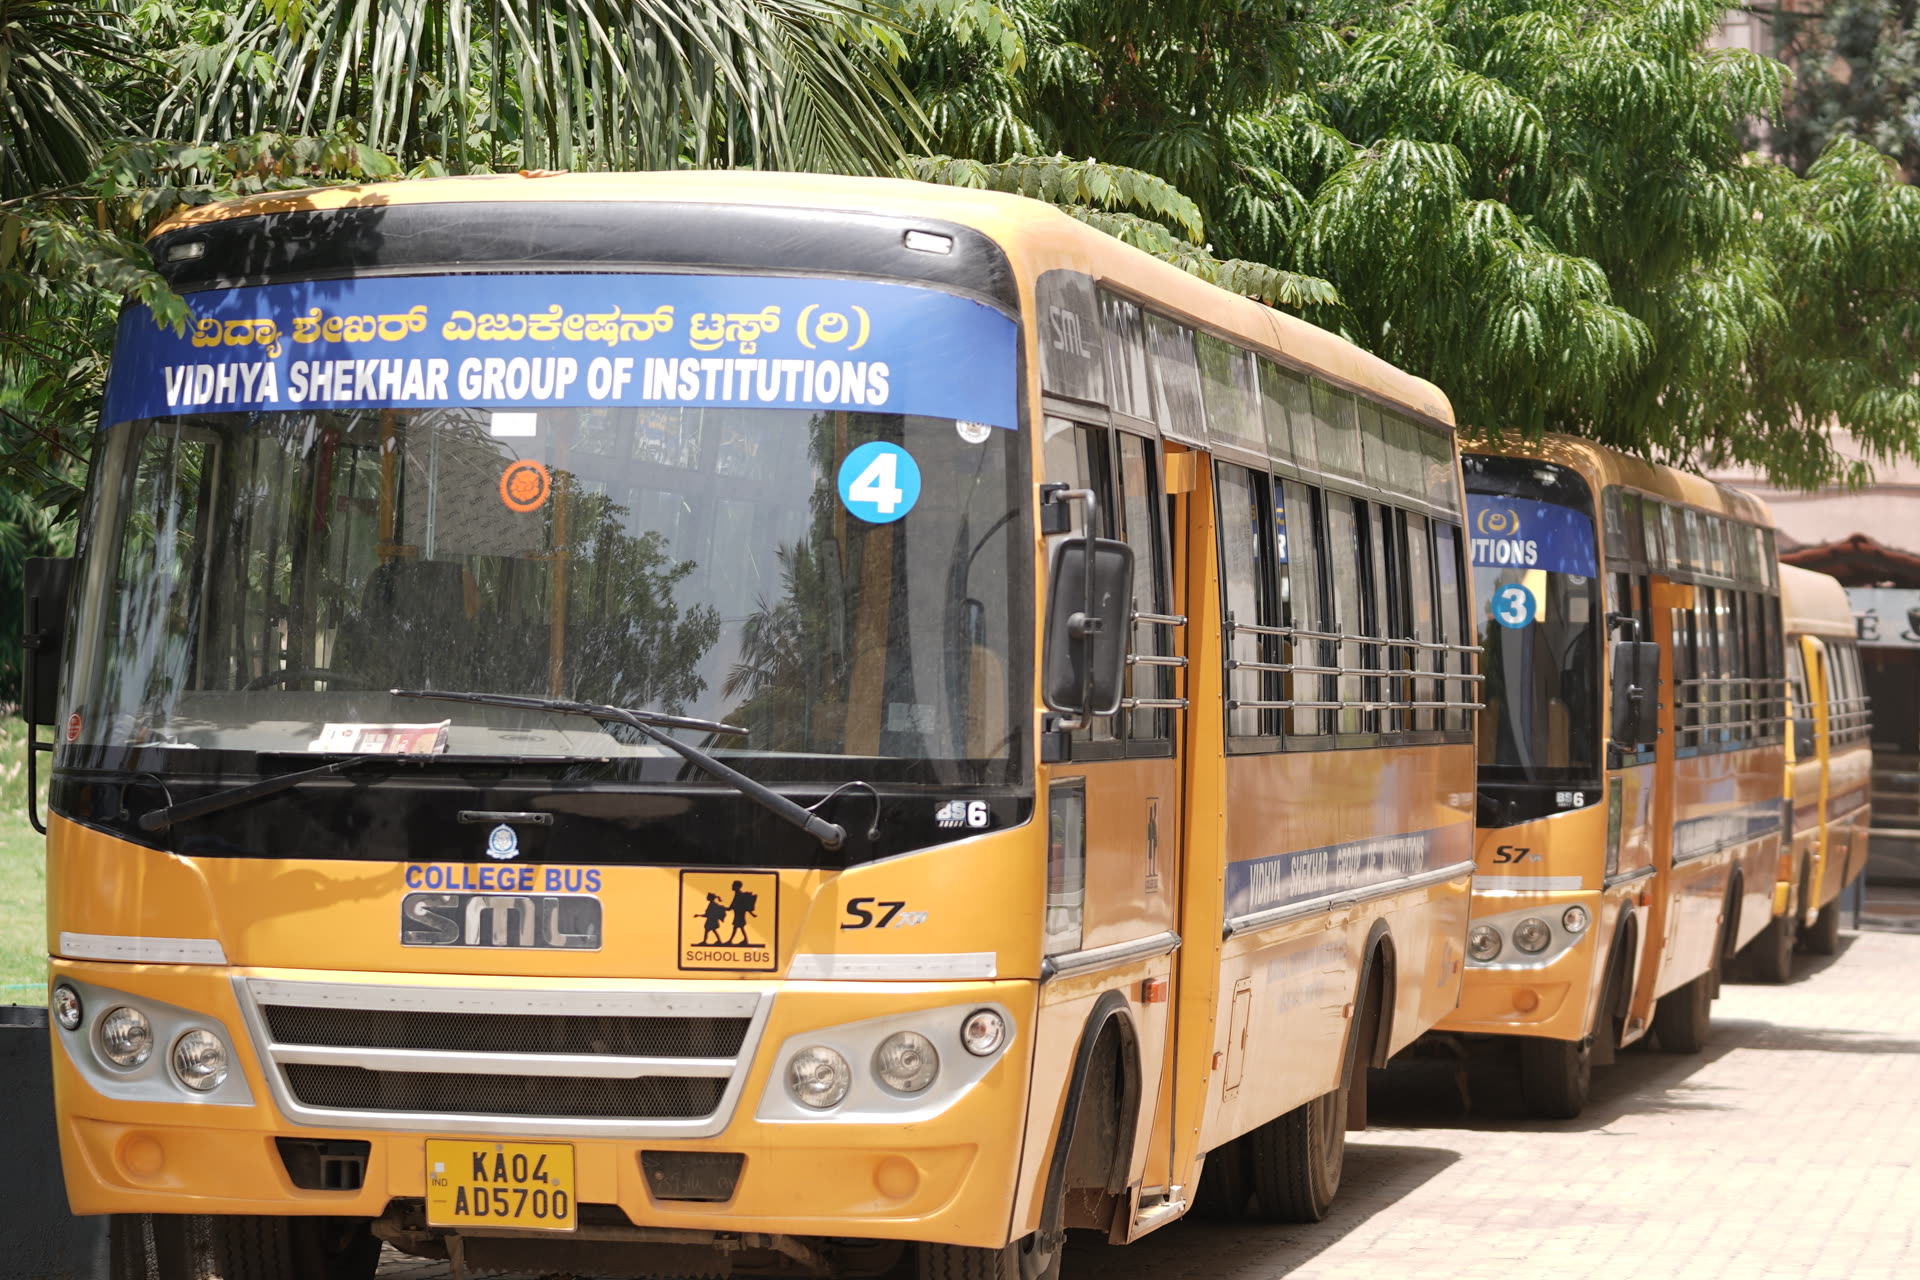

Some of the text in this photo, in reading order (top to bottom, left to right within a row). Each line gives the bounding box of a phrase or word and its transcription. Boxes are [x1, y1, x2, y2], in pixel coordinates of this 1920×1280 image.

[191, 303, 871, 359] ವಿದ್ಯಾ ಶೇಖರ್ ಎಜುಕೇಷನ್ ಟ್ರಸ್ಟ್ (ರಿ)
[164, 356, 890, 407] VIDHYA SHEKHAR GROUP OF INSTITUTIONS
[848, 452, 903, 514] 4
[1500, 588, 1528, 624] 3
[404, 864, 603, 893] COLLEGE BUS
[1249, 859, 1281, 907] VIDHYA
[1289, 851, 1329, 897] SHEKHAR
[1335, 845, 1362, 887] GROUP
[1366, 842, 1377, 880] OF
[403, 893, 598, 948] SML
[840, 896, 906, 930] S7
[686, 950, 770, 963] SCHOOL BUS
[431, 1177, 448, 1187] IND
[472, 1151, 549, 1184] KA04
[454, 1185, 568, 1220] AD5700
